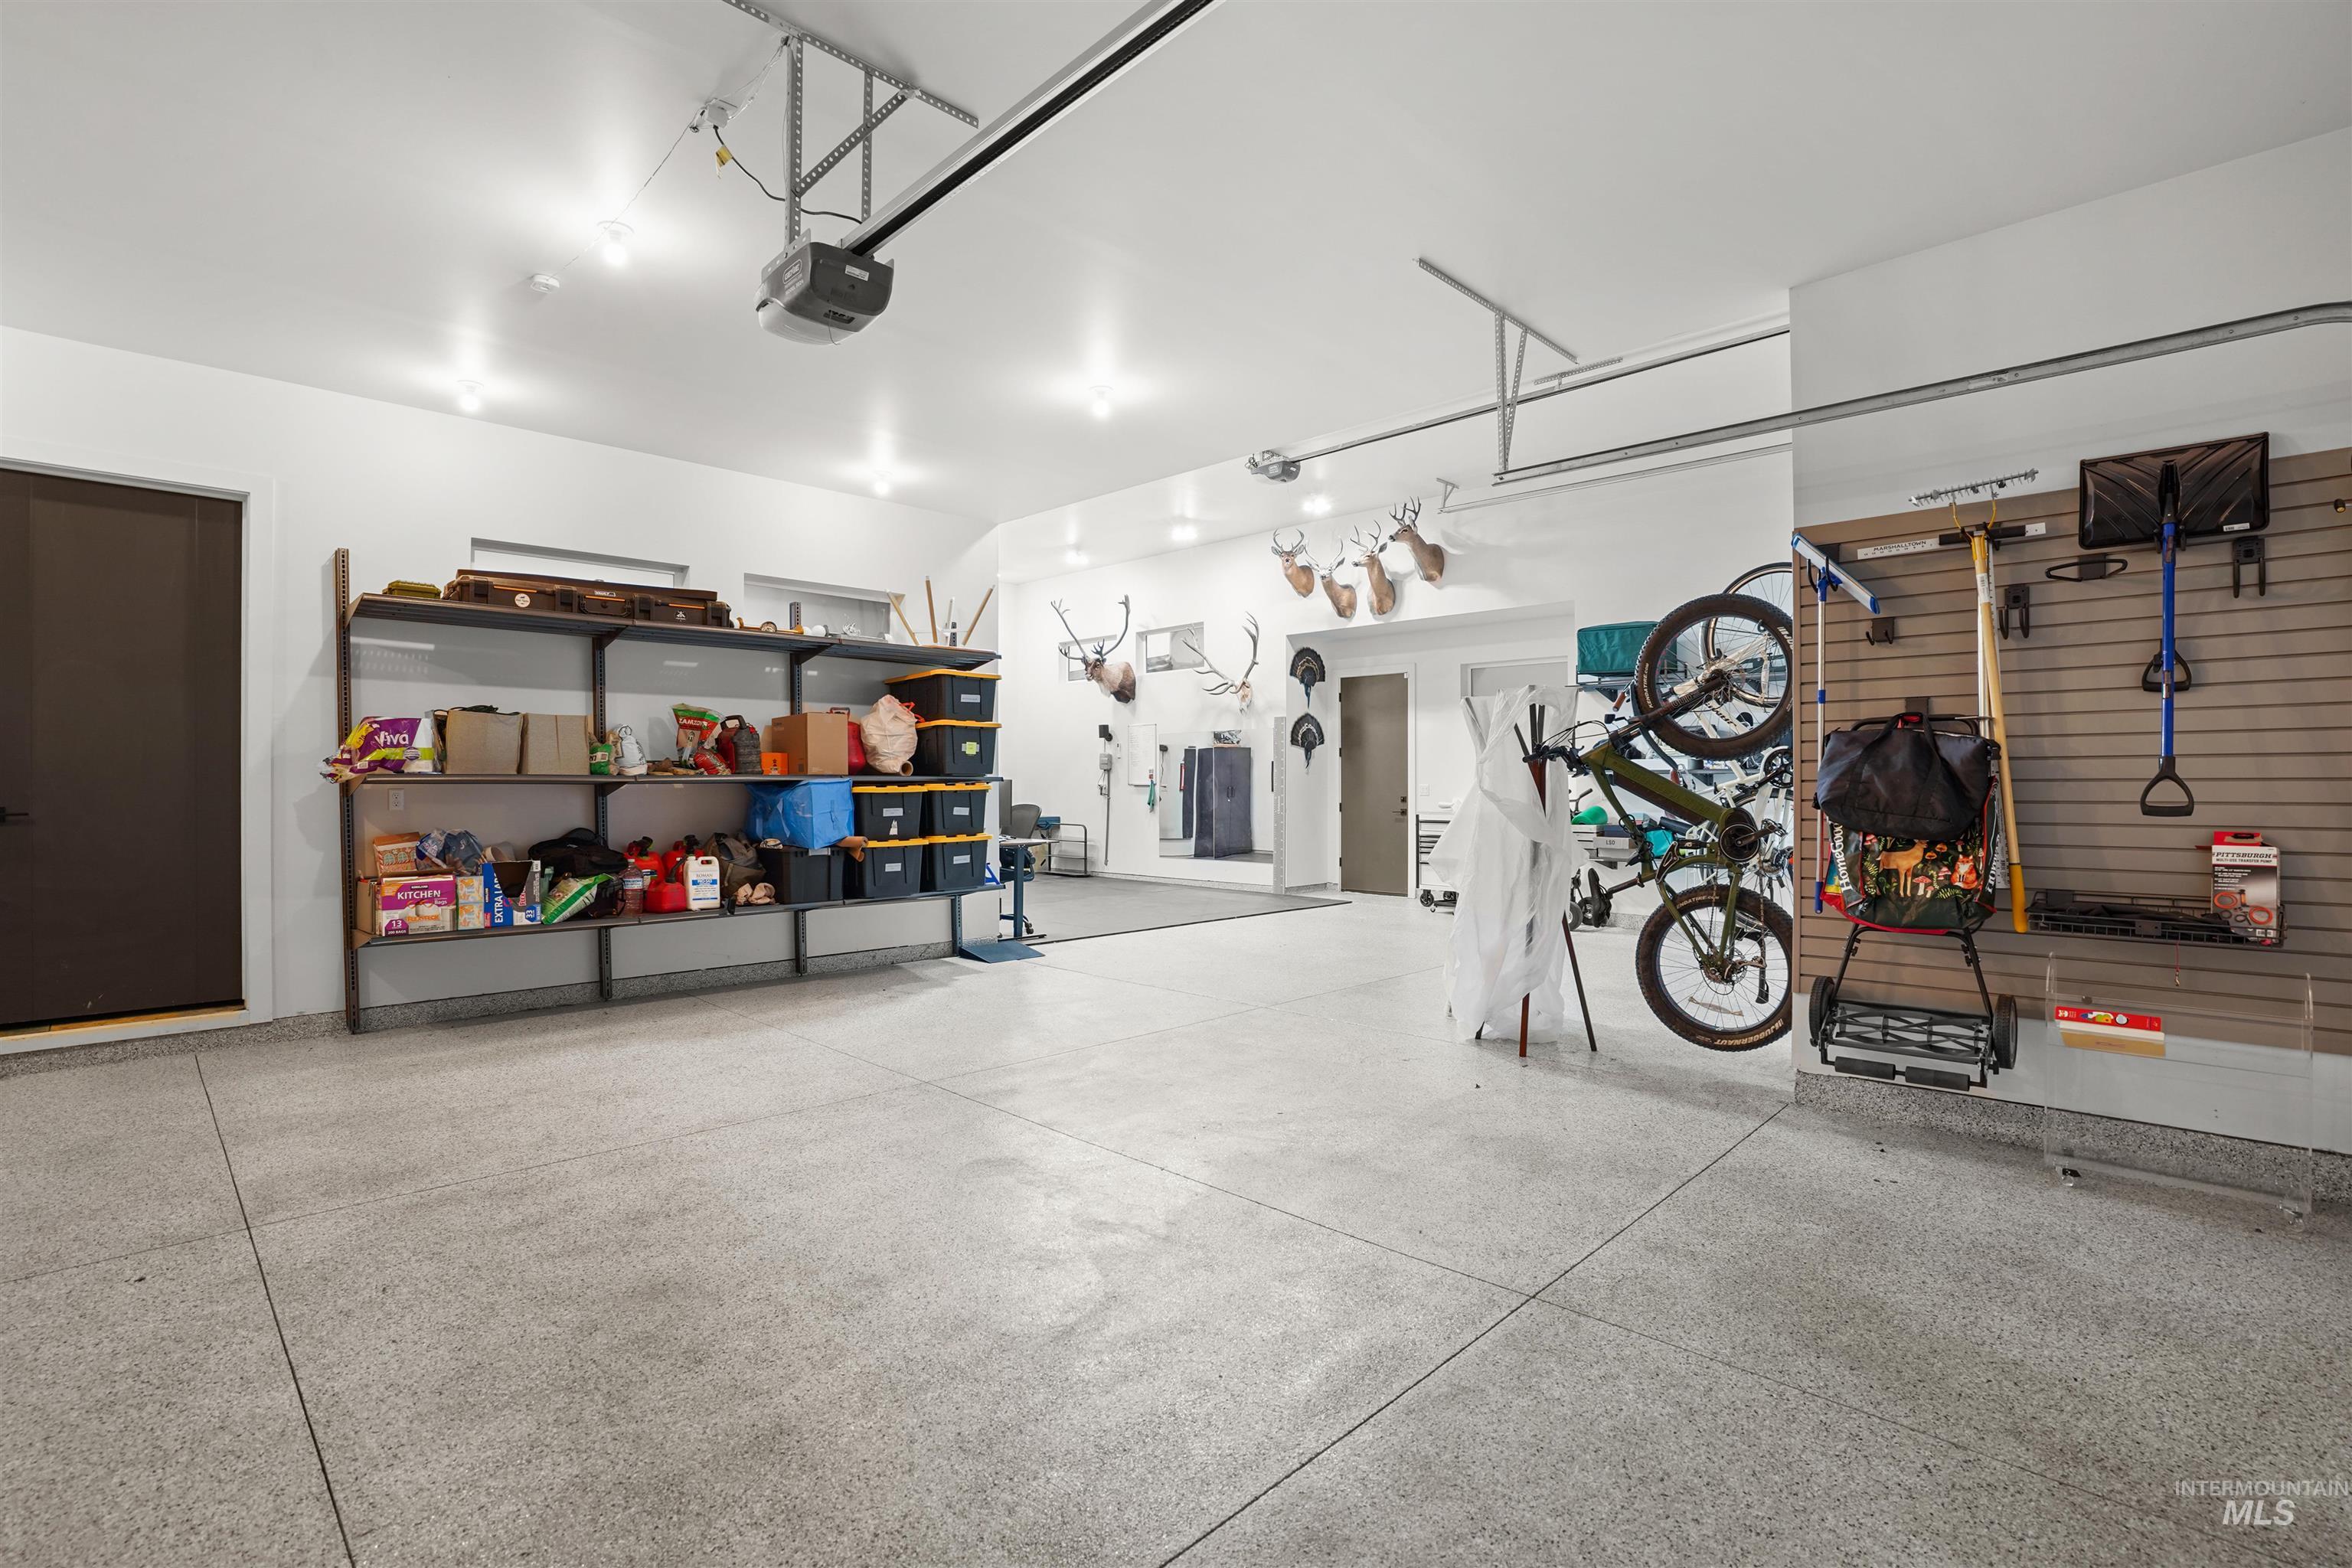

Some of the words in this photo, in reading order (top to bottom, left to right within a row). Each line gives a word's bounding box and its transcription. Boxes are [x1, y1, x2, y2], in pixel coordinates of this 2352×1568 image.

[1873, 541, 1926, 551] MARSHALLTOWN
[397, 890, 441, 900] KITCHEN
[495, 896, 503, 923] EXTRA
[526, 910, 533, 918] 33
[1714, 1024, 1775, 1045] JUGGERNAUT
